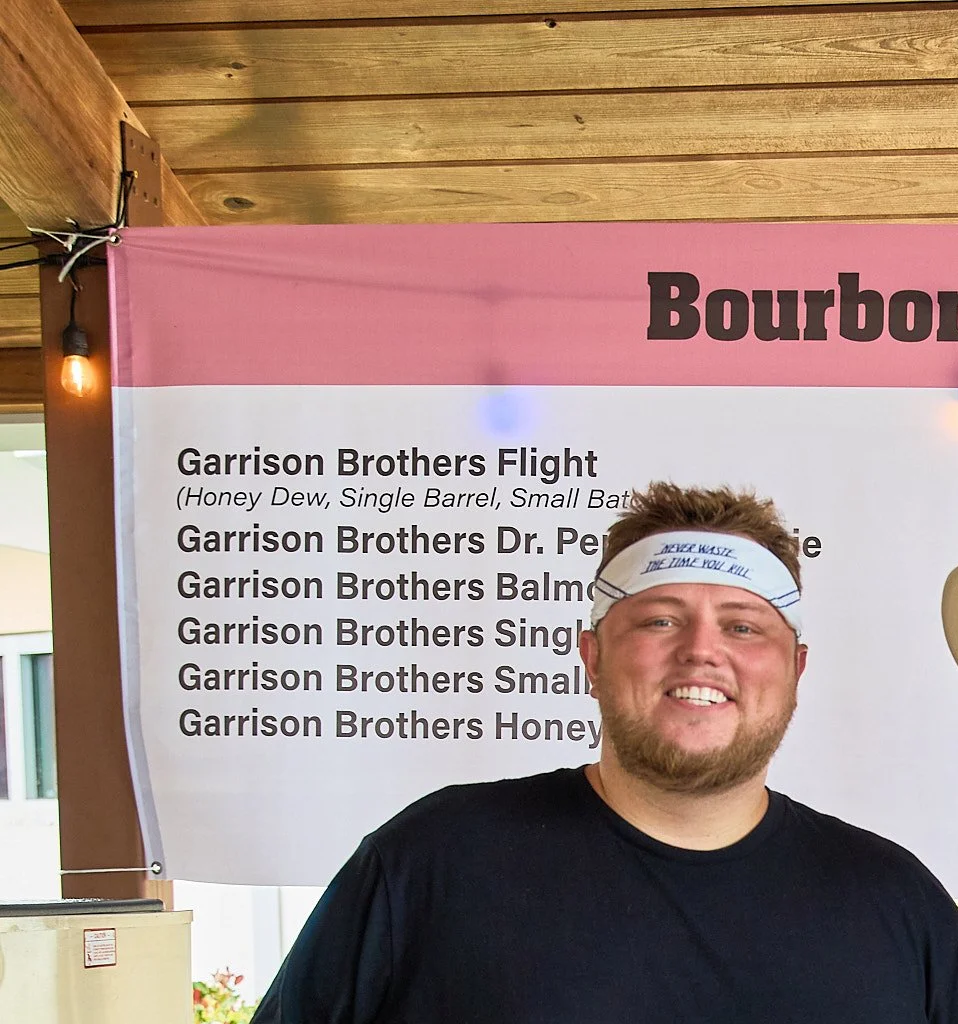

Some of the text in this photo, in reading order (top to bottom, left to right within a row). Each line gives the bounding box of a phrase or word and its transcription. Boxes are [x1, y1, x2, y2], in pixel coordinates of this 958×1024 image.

[178, 447, 597, 484] Garrison Brothers Flight
[176, 486, 262, 511] (Honey
[271, 487, 330, 509] Dew,
[340, 487, 414, 513] Single
[424, 487, 501, 510] Barrel,
[510, 488, 579, 508] Small
[178, 523, 322, 553] Garrison
[338, 525, 485, 555] Brothers
[498, 526, 543, 554] Dr.
[699, 544, 734, 557] WASTE
[644, 558, 664, 574] THE
[668, 557, 698, 568] TIME
[702, 559, 723, 570] YOU
[178, 570, 322, 599] Garrison
[338, 572, 485, 601] Brothers
[178, 616, 322, 645] Garrison
[337, 618, 484, 647] Brothers
[179, 662, 591, 694] Garrison Brothers Small
[180, 708, 601, 749] Garrison Brothers Honey
